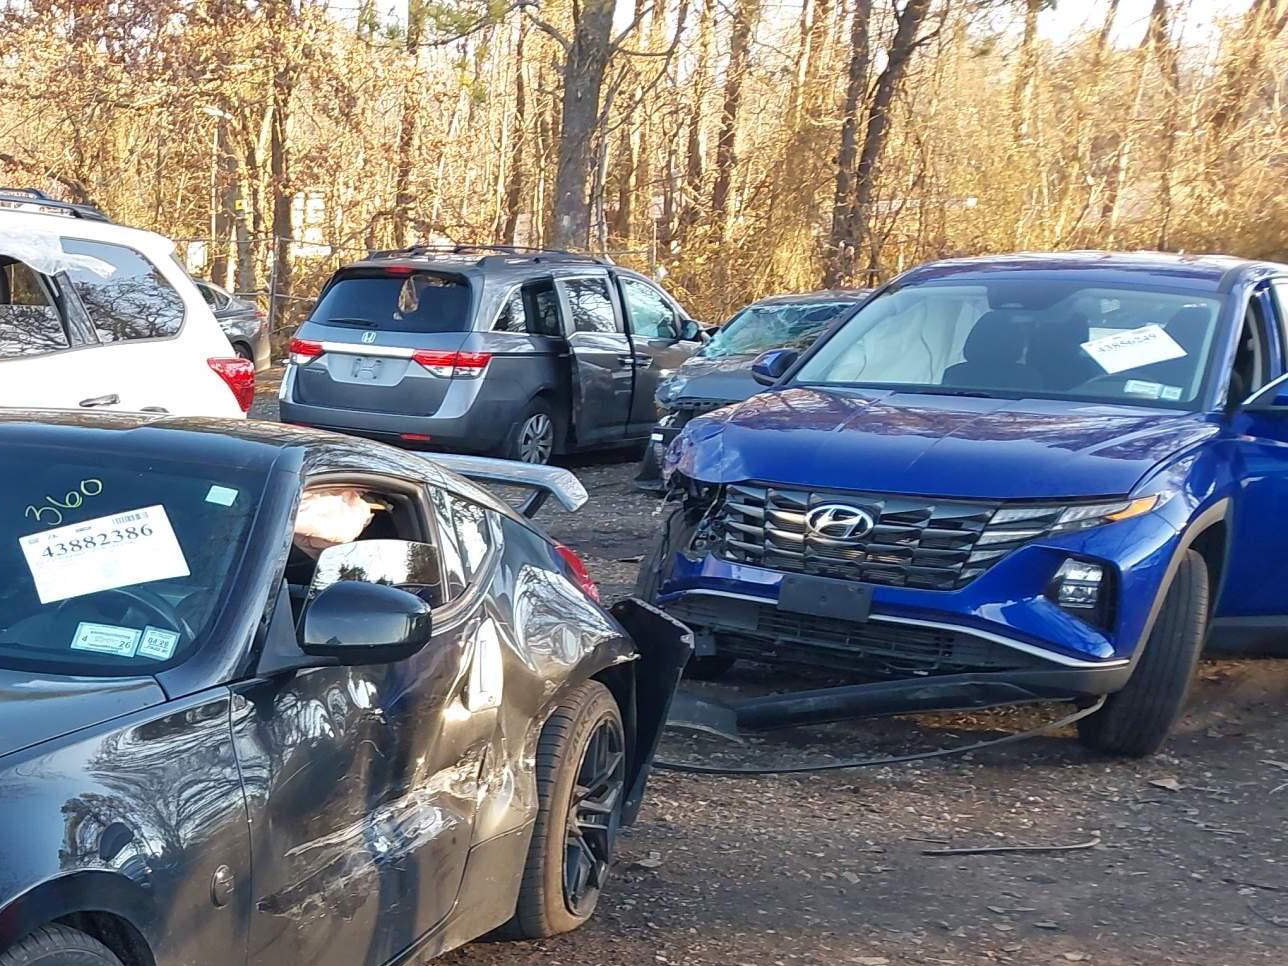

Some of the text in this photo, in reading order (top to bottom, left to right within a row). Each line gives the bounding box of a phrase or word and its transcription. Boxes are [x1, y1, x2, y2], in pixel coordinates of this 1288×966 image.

[24, 479, 104, 526] 360
[41, 523, 154, 558] 43882386
[119, 641, 132, 649] 26
